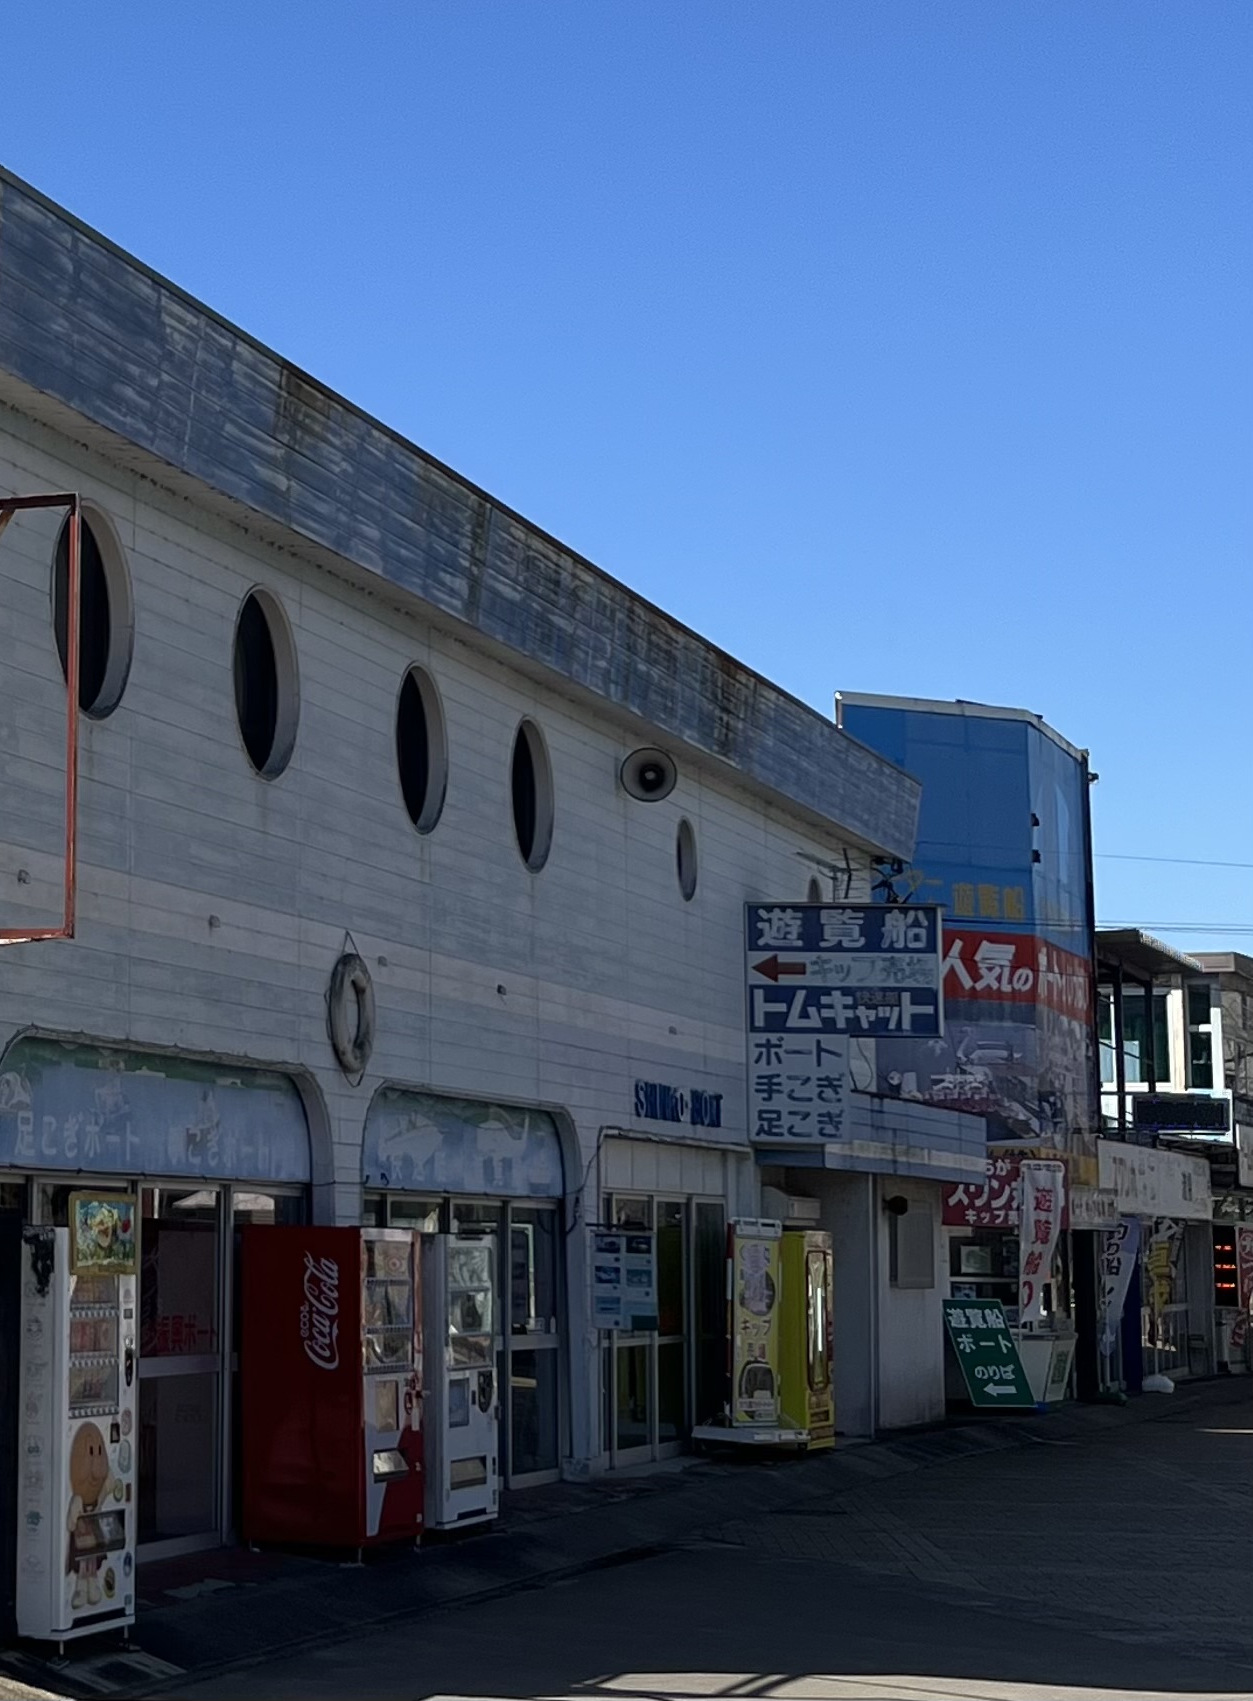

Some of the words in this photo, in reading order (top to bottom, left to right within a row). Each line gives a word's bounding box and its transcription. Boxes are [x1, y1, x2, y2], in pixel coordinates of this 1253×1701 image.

[757, 908, 928, 948] 遊覧船
[753, 989, 935, 1030] トムキャット
[754, 1036, 842, 1067] ボート
[754, 1073, 844, 1103] 手こぎ
[15, 1109, 140, 1161] 足こぎボート
[755, 1108, 844, 1137] 足こぎ
[957, 1333, 1012, 1354] ボート
[975, 1364, 1015, 1380] のりば
